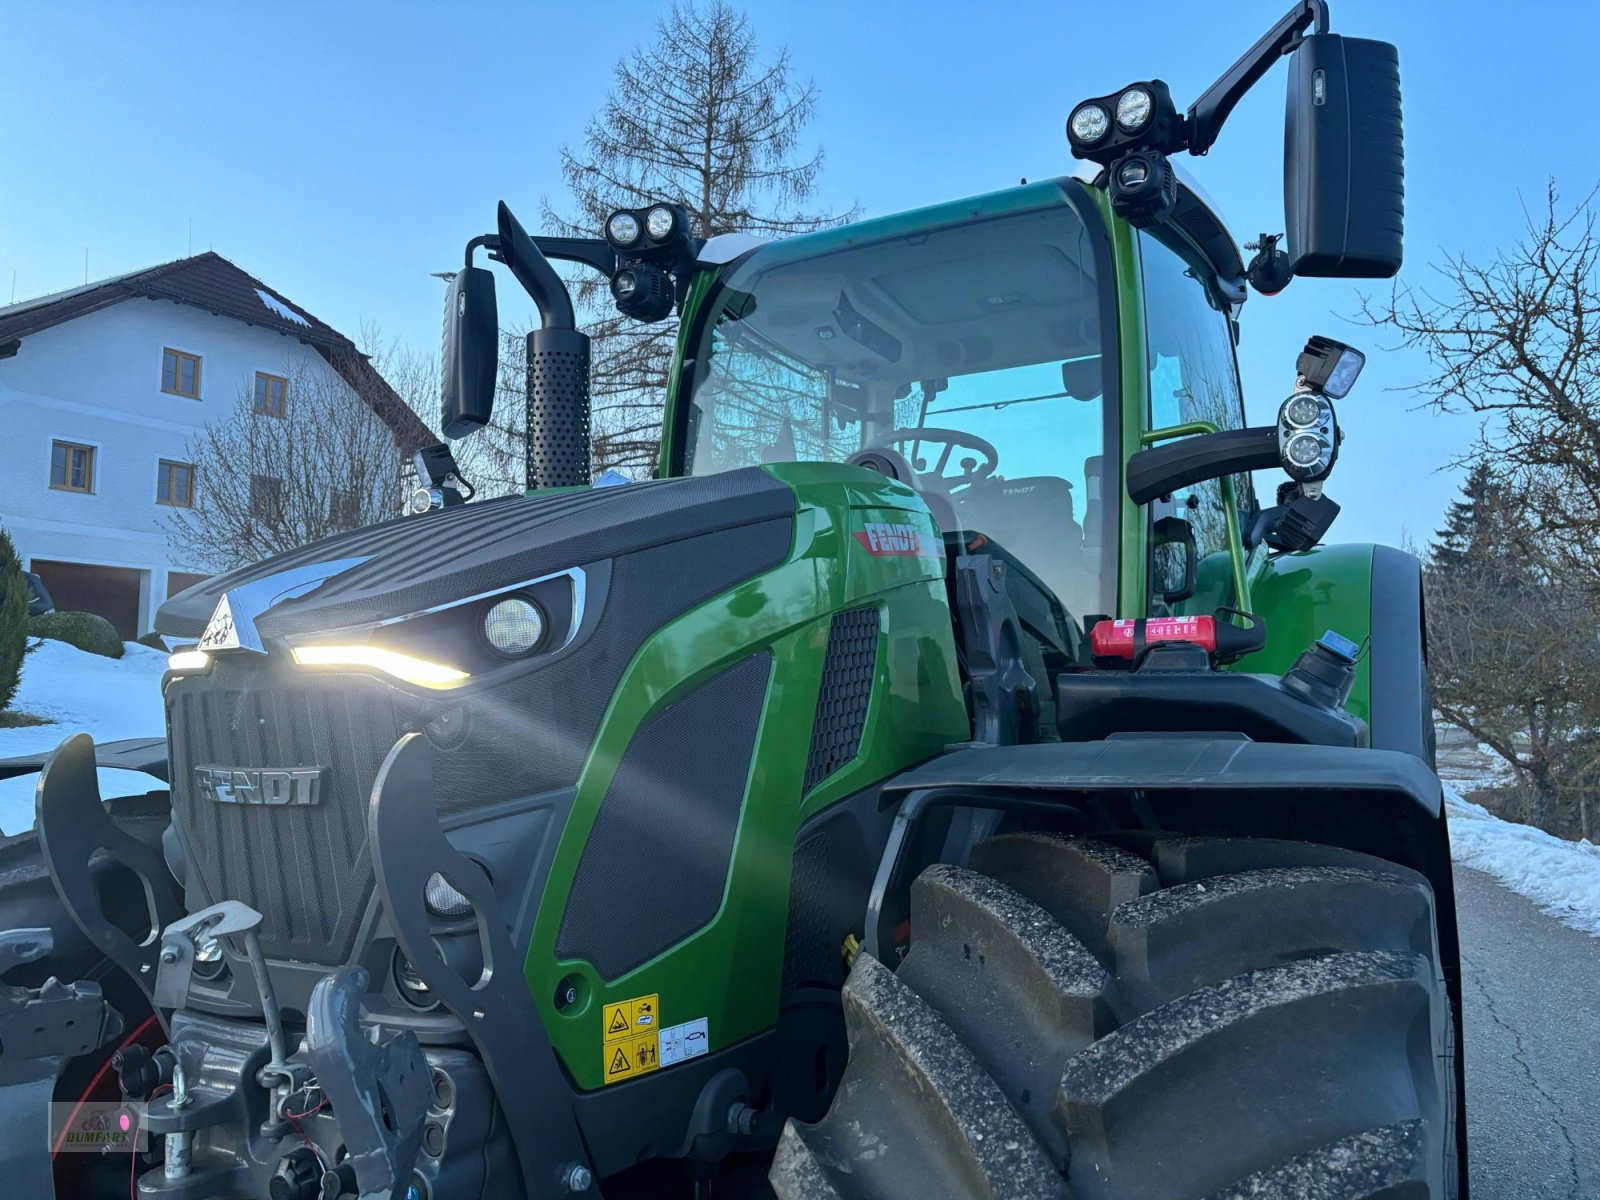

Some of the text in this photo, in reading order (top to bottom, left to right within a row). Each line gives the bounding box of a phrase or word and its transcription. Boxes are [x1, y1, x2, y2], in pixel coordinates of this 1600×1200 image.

[1002, 486, 1036, 495] FENDT
[864, 522, 917, 552] FENDT
[196, 768, 320, 804] FENDT
